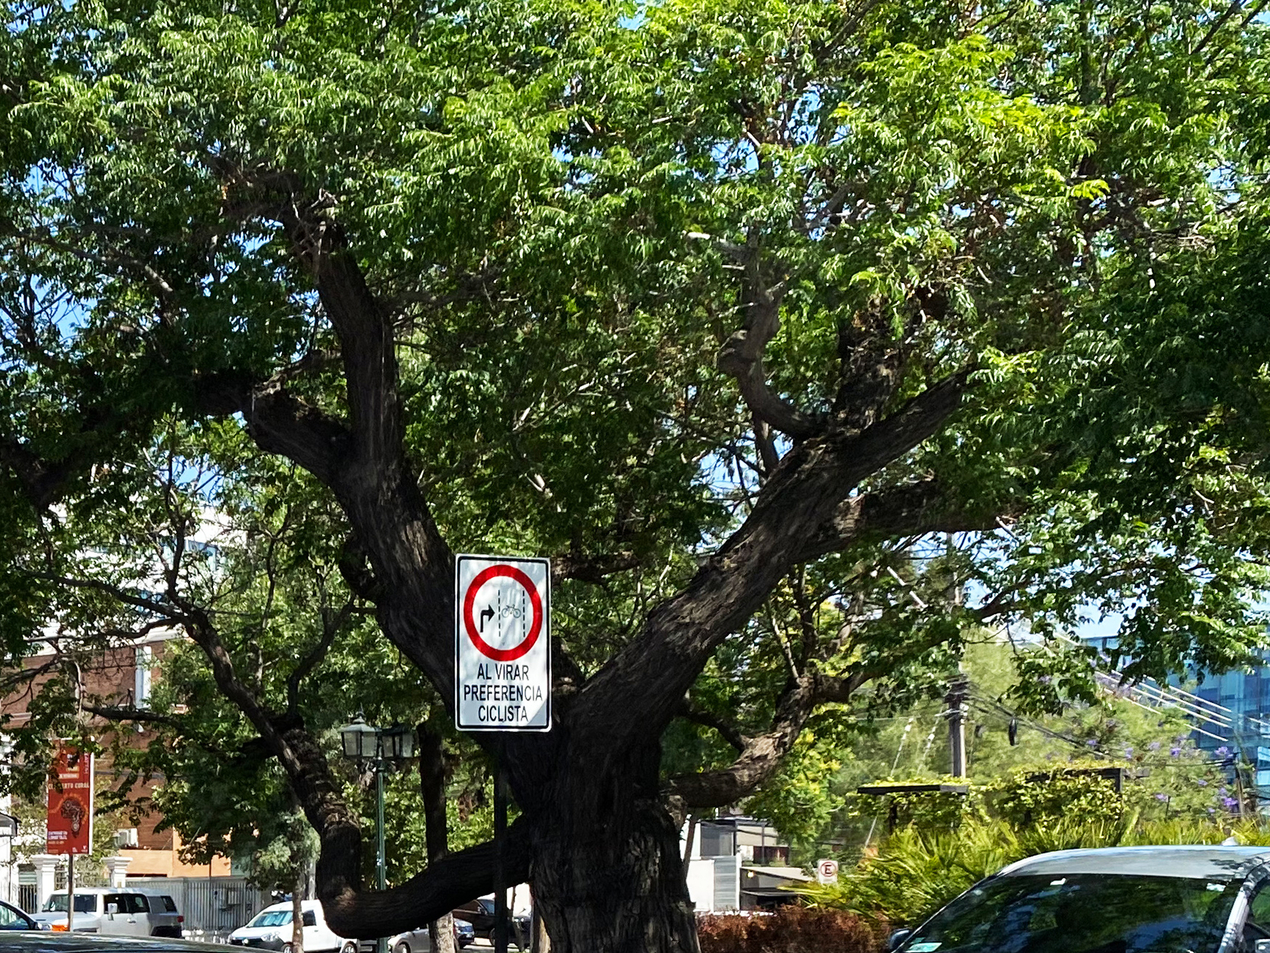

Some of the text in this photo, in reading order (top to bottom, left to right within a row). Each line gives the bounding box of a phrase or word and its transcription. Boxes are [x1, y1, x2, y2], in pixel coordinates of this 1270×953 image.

[477, 663, 529, 681] AL VIRAR
[463, 684, 543, 701] PREFERENCIA
[478, 705, 529, 722] CICLISTA
